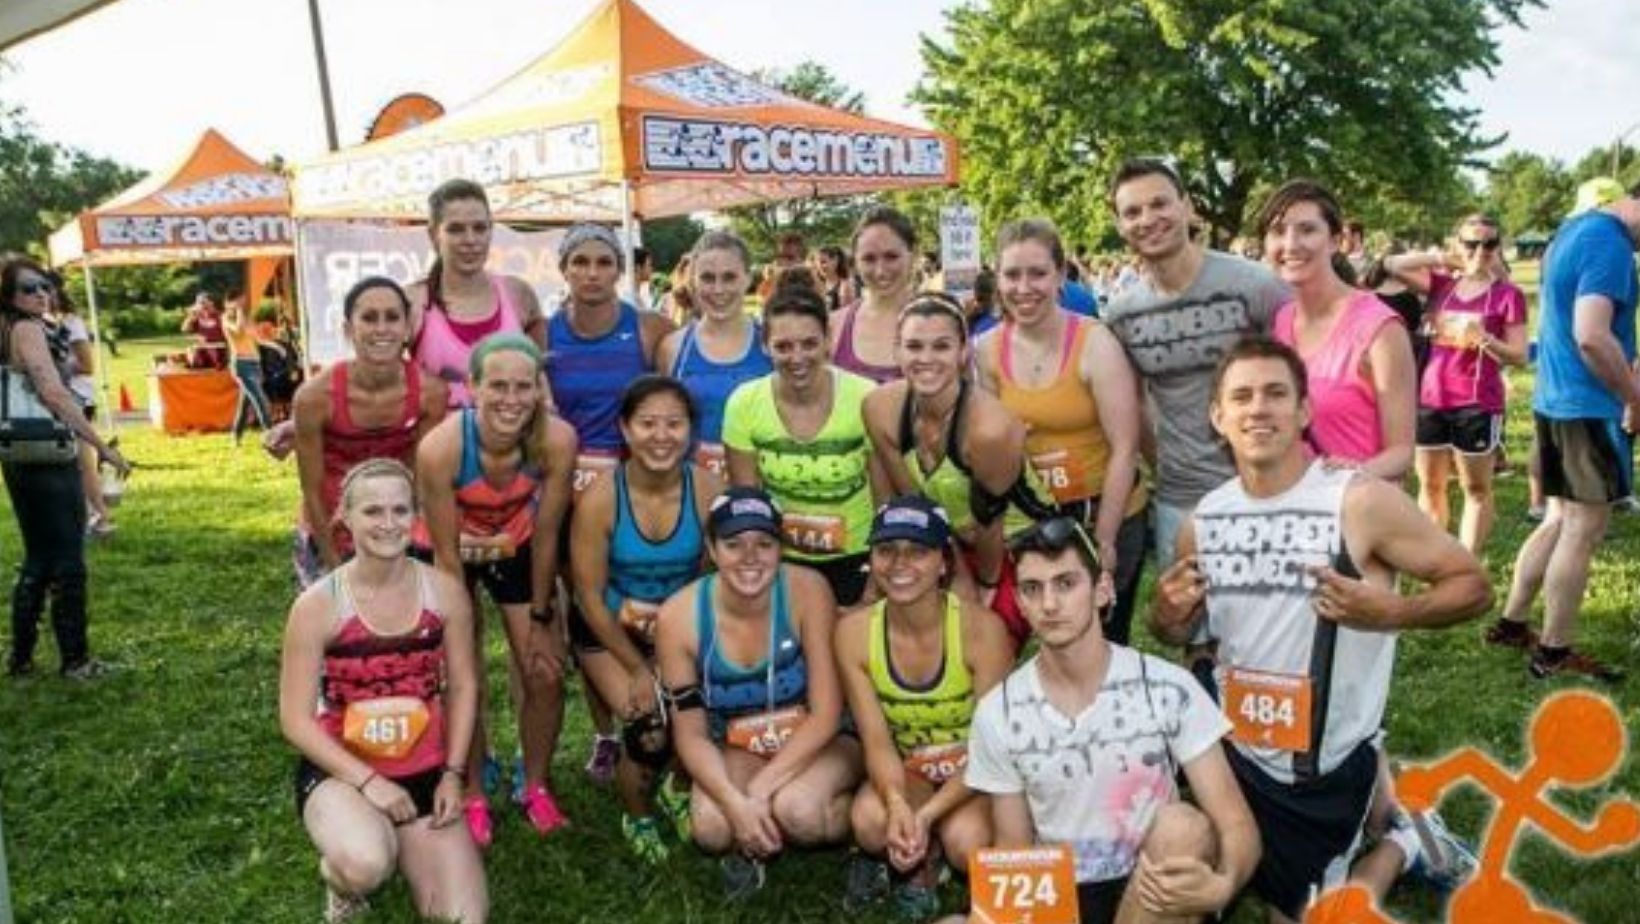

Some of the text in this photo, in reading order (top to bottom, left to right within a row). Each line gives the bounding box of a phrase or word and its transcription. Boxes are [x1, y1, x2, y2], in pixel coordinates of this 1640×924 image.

[722, 124, 925, 175] racemenu
[1241, 692, 1295, 728] 484
[363, 717, 408, 743] 461
[988, 872, 1059, 909] 724
